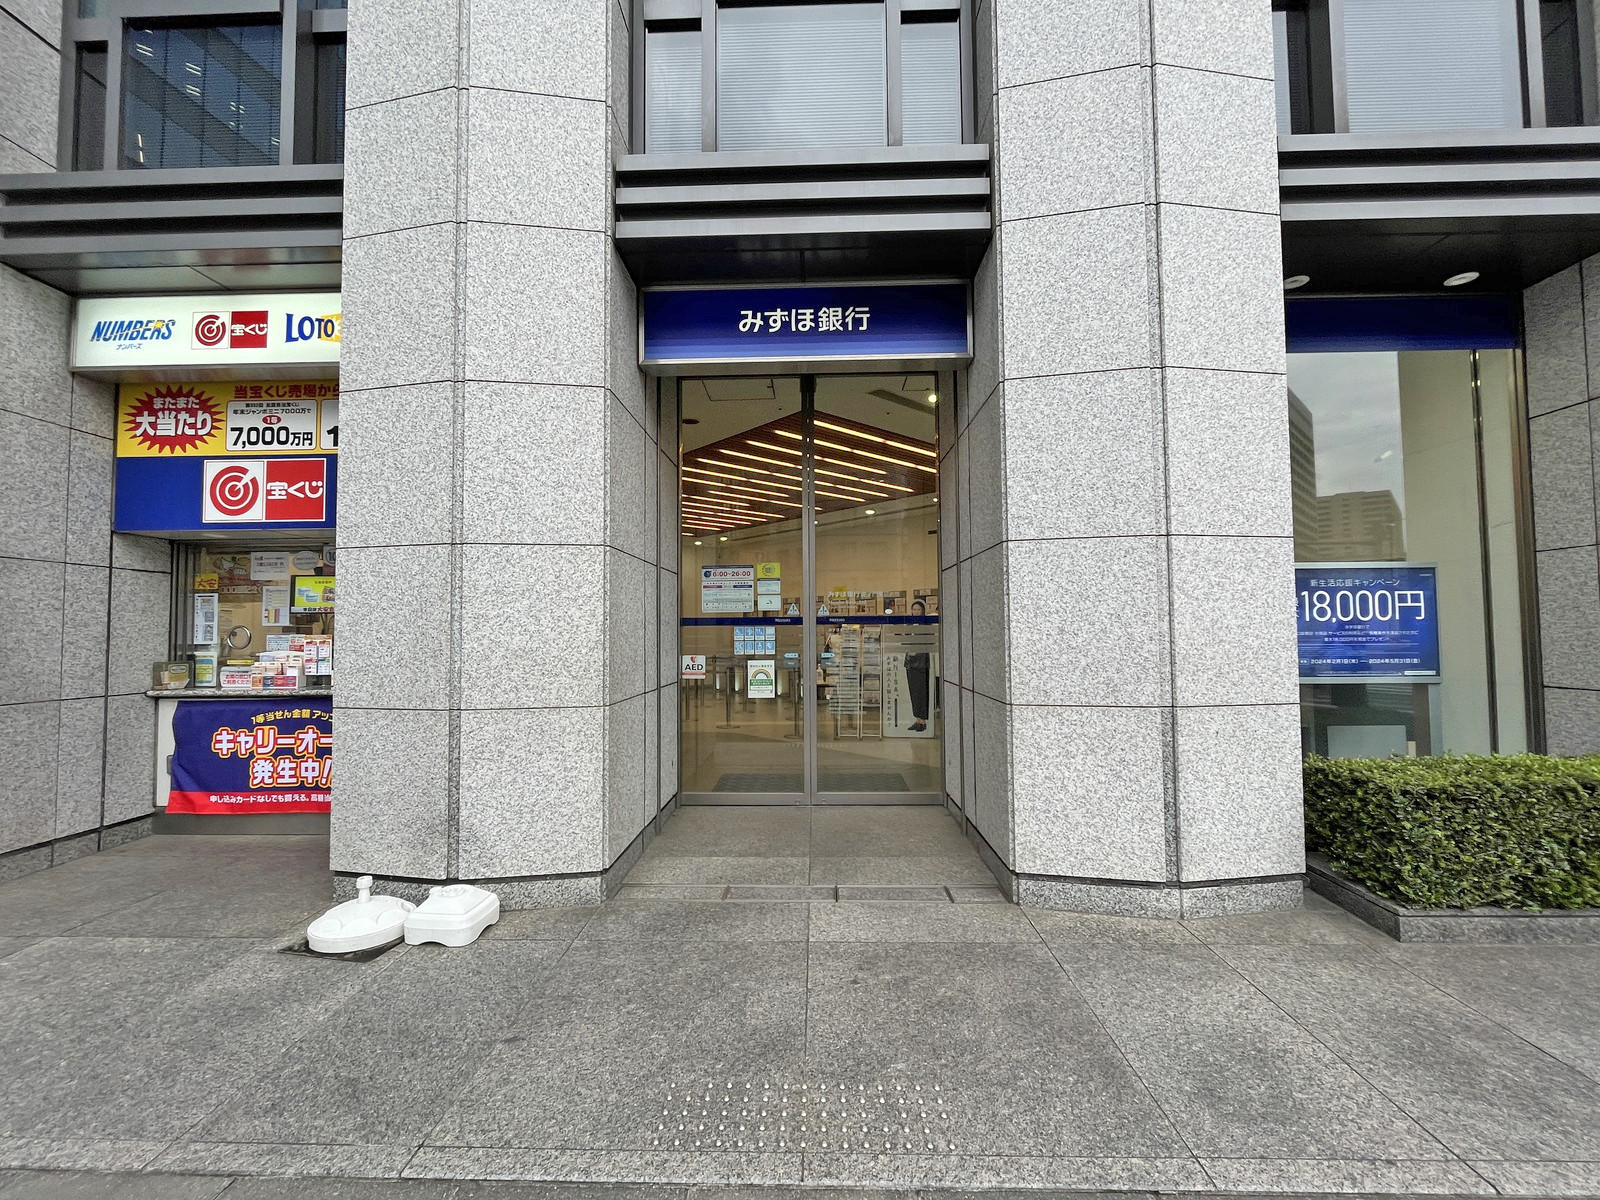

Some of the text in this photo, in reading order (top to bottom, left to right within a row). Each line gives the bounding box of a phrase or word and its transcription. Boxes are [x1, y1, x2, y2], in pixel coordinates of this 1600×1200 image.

[738, 306, 870, 333] みずほ銀行
[89, 319, 177, 342] NUMBERS
[230, 323, 269, 336] 宝くじ
[115, 342, 143, 351] ナンバーズ
[153, 396, 200, 409] またまた
[135, 410, 213, 437] 大当たり
[230, 425, 314, 449] 7,000万円
[266, 481, 324, 500] 宝くじ
[1310, 579, 1400, 588] 新生活応援キャンペーン
[1300, 589, 1425, 623] 18,000円
[684, 663, 704, 671] AED
[250, 708, 311, 725] 1等当せん金額
